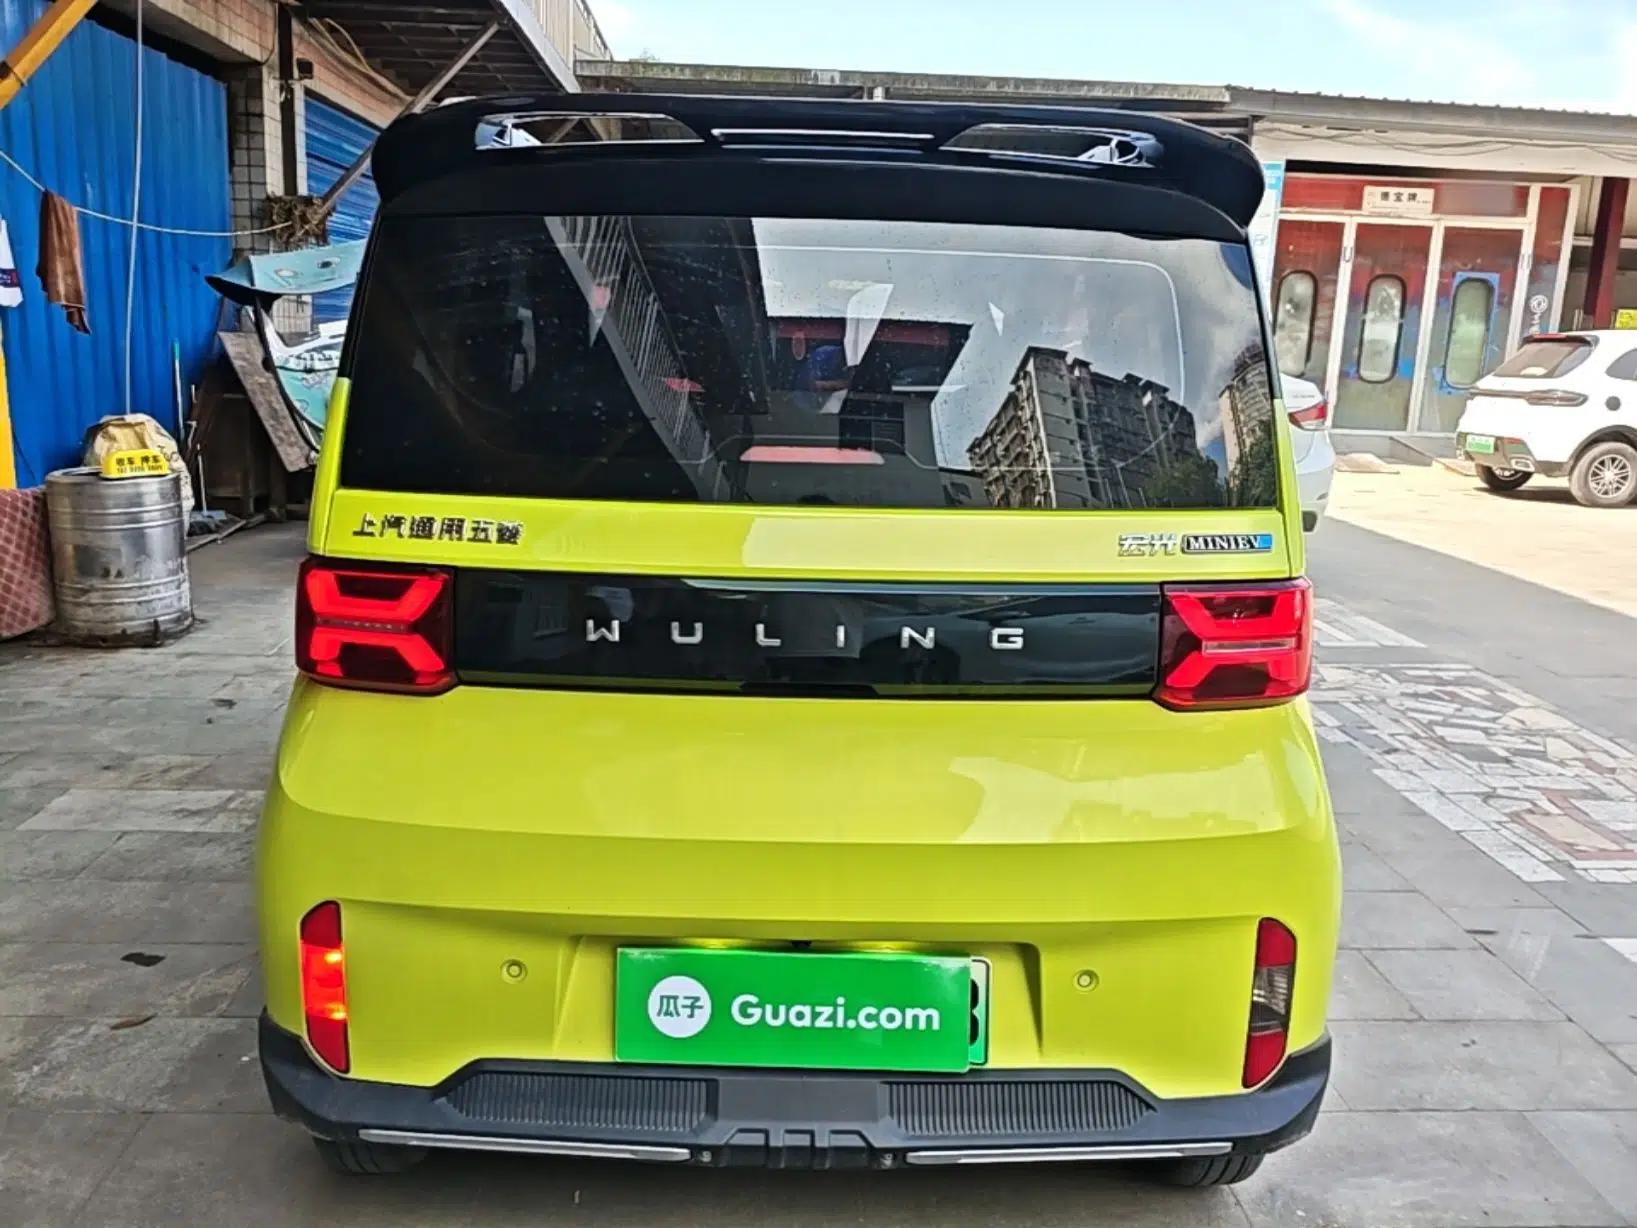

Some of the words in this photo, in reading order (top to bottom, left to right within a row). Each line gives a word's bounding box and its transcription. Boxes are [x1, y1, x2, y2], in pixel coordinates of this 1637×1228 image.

[352, 513, 523, 545] 上汽通用五菱
[1118, 533, 1177, 557] 宏光
[1188, 535, 1261, 550] MINIEV
[586, 618, 1025, 650] WULING
